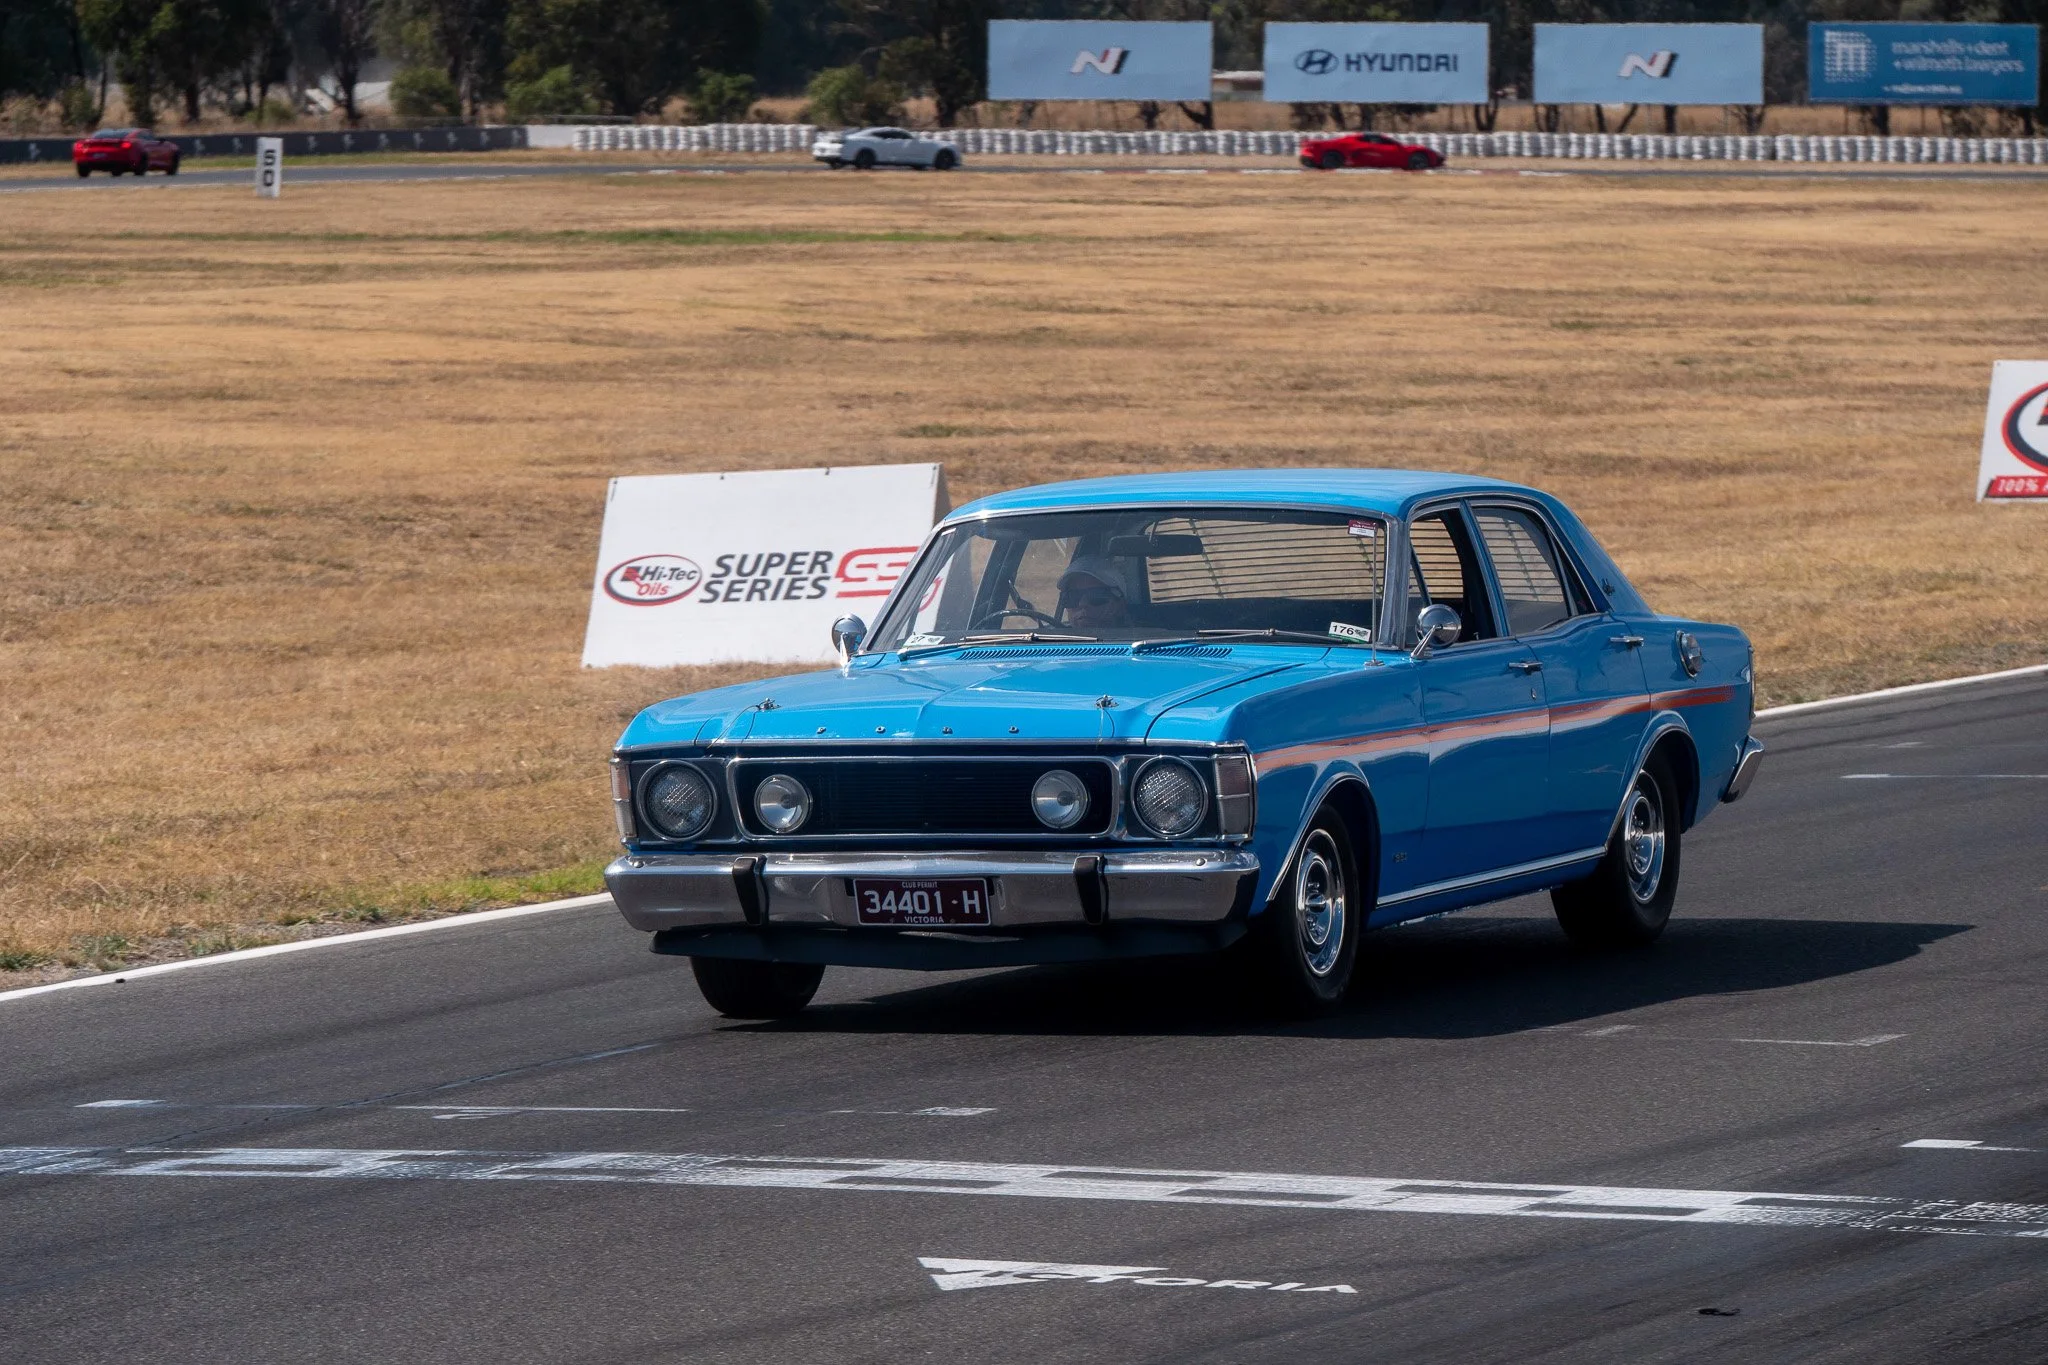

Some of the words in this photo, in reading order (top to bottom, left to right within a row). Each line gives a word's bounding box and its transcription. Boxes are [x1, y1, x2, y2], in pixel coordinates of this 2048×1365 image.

[1346, 53, 1458, 72] HYUNDAI
[1998, 478, 2038, 492] 100%
[710, 551, 834, 578] SUPER
[641, 565, 698, 581] Hi-Tec
[637, 583, 669, 596] Oils
[698, 576, 831, 603] SERIES
[1332, 625, 1355, 636] 176
[864, 890, 943, 914] 34401
[904, 916, 944, 924] VICTORIA
